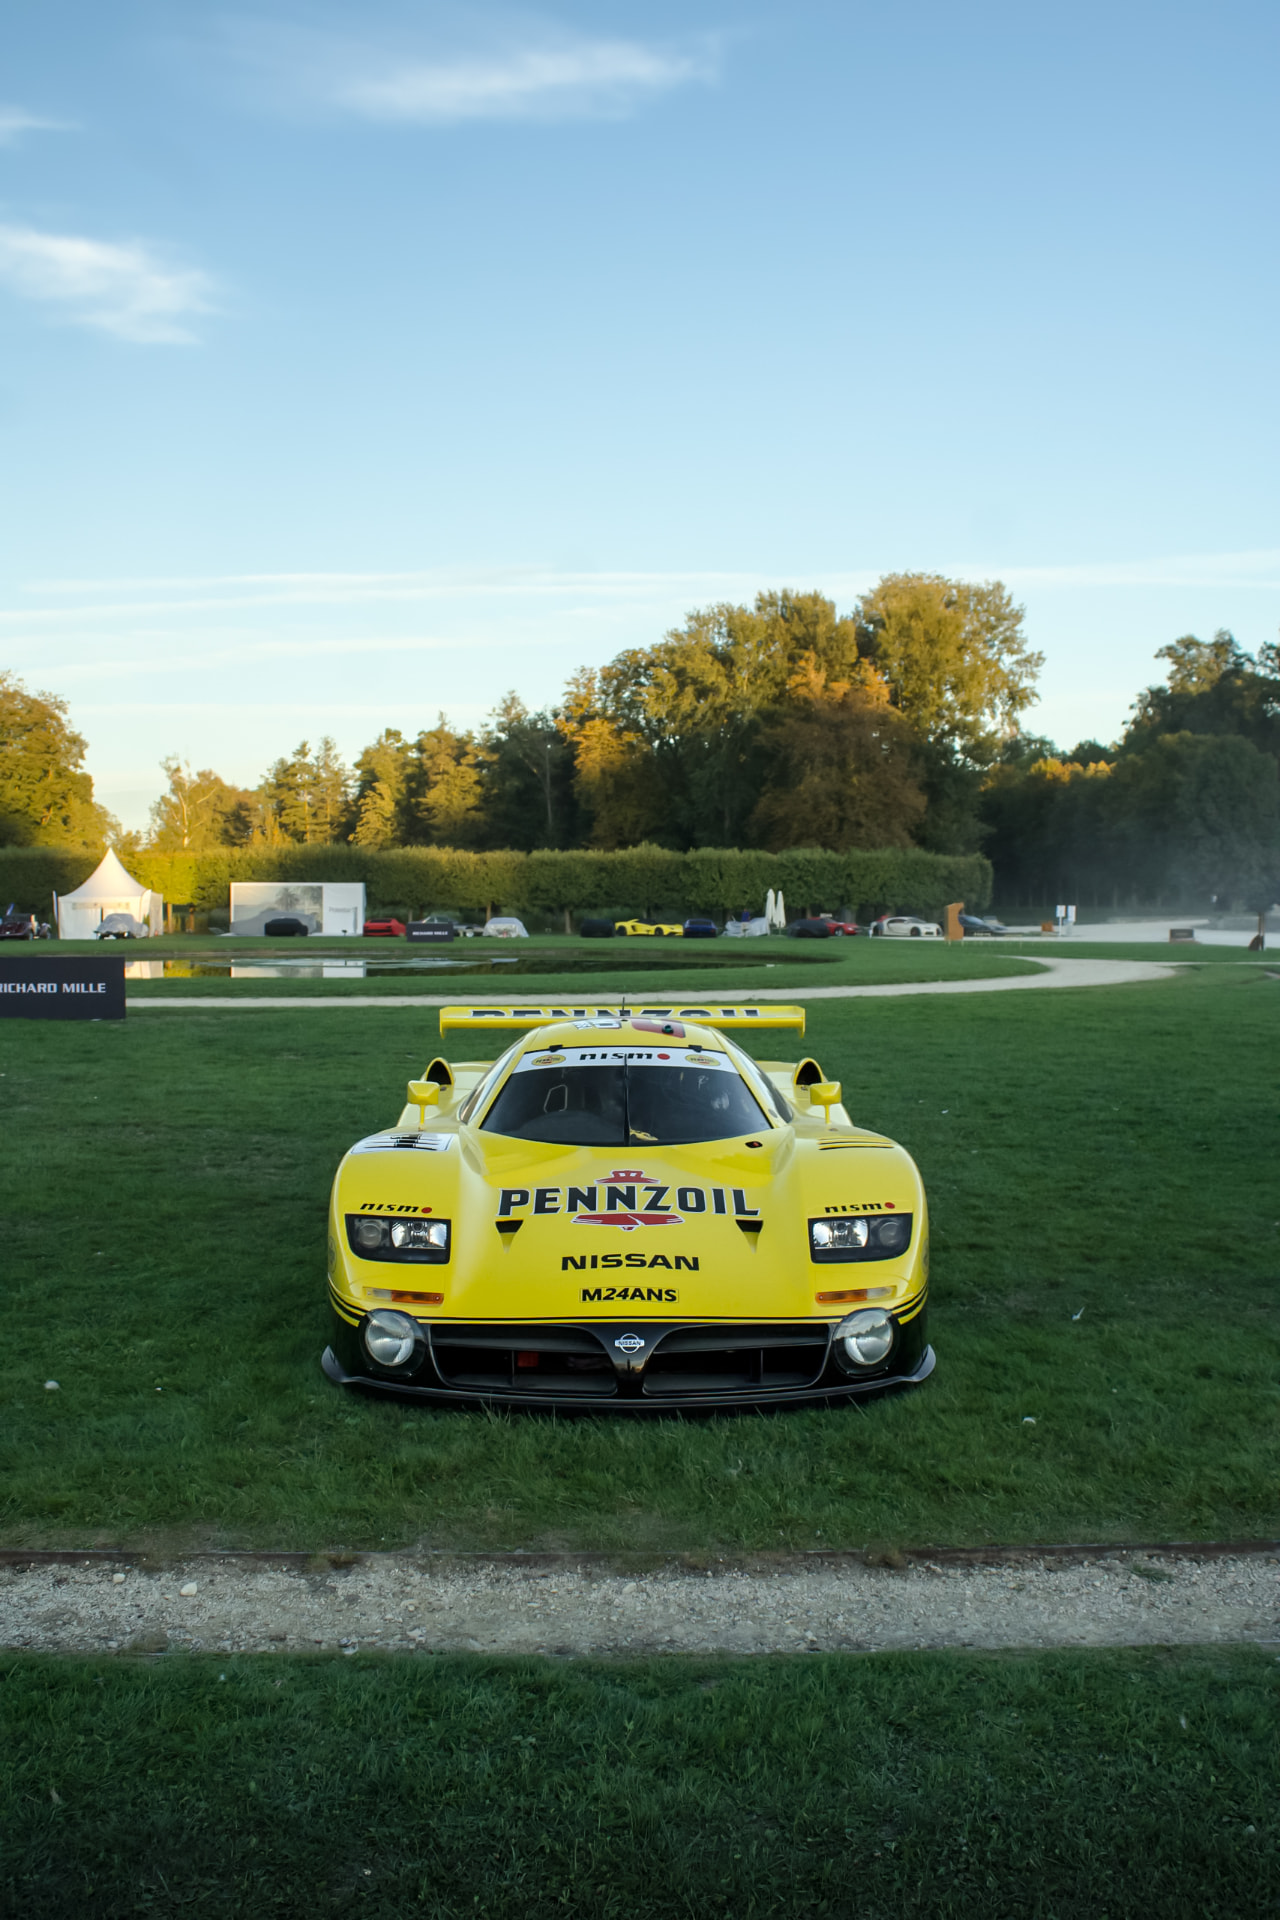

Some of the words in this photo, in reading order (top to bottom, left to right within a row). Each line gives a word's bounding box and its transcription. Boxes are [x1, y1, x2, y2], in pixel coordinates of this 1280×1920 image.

[0, 983, 58, 993] ICHARD
[62, 983, 106, 993] MILLE
[496, 1185, 760, 1216] PENNZOIL
[561, 1253, 700, 1271] NISSAN
[581, 1287, 678, 1302] M24ANS
